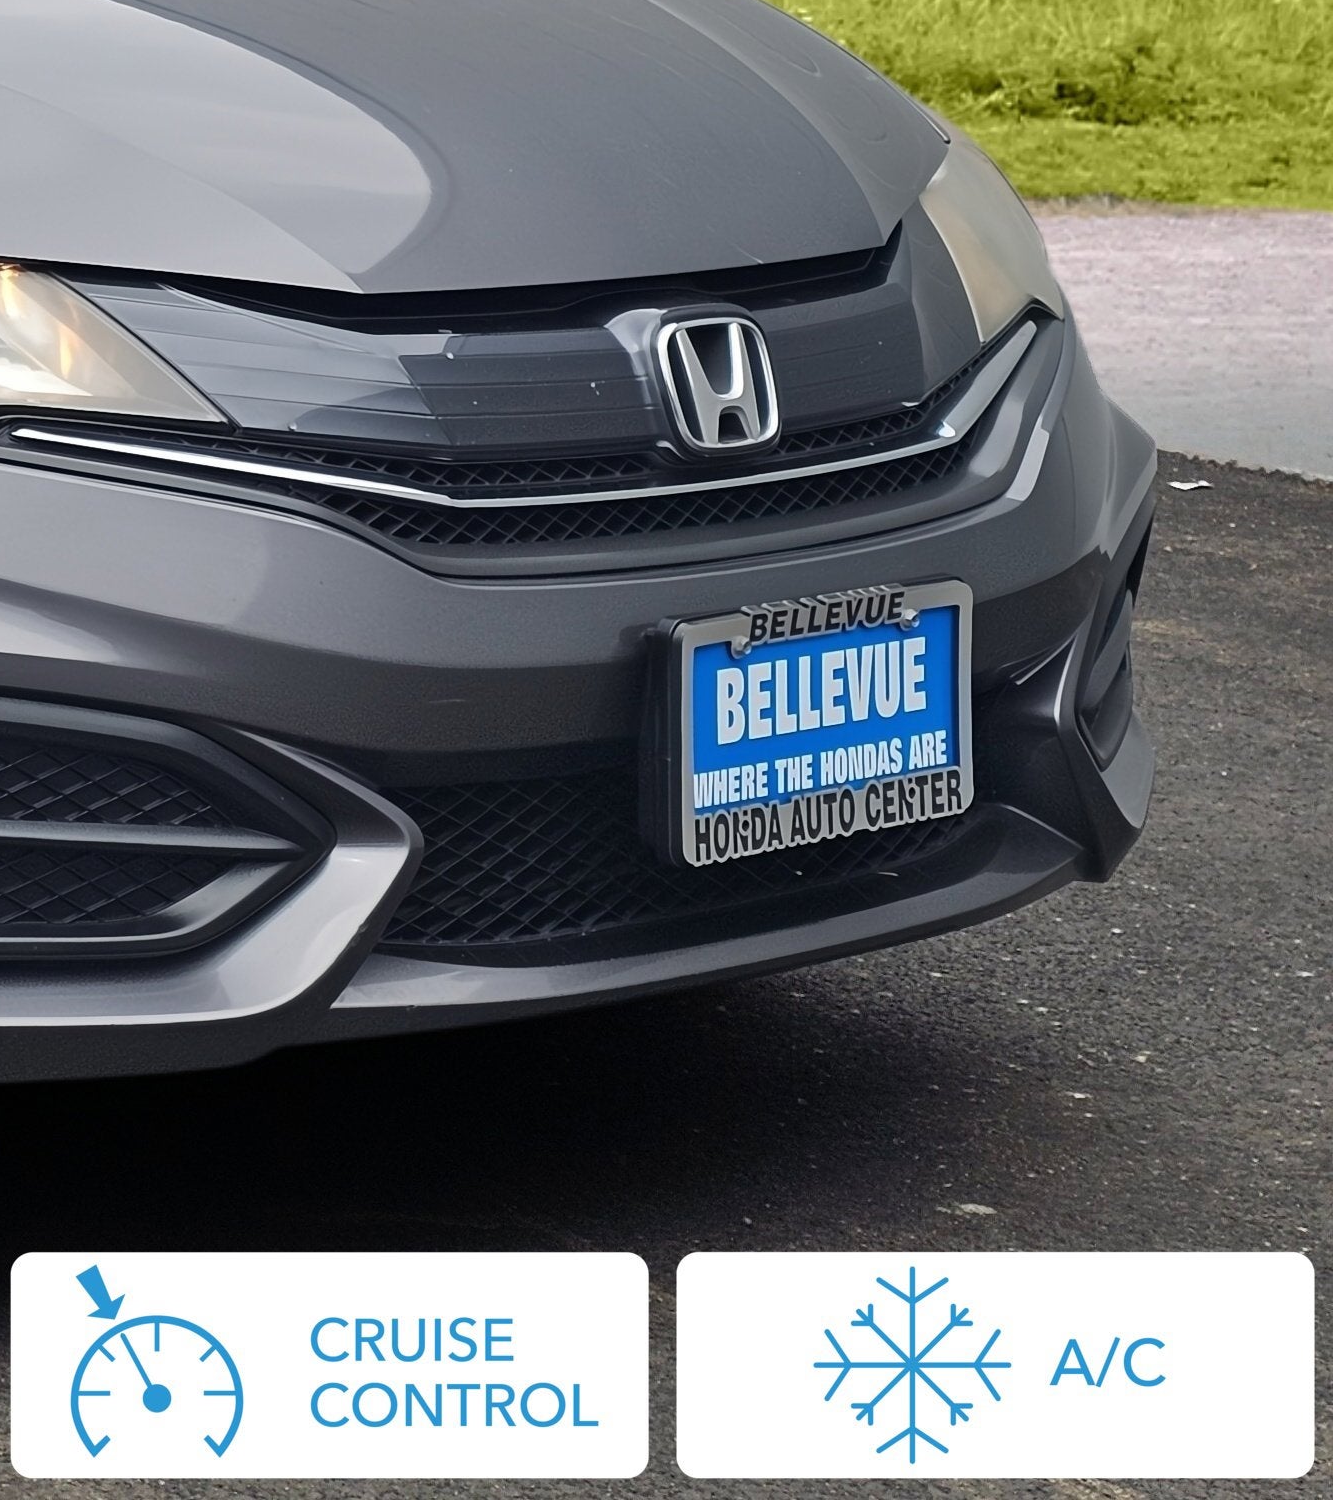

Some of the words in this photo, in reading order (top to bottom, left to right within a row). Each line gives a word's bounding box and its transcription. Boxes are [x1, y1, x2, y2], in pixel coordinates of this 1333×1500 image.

[748, 590, 906, 642] BELLEVUE
[716, 636, 927, 746] BELLEVUE
[693, 761, 769, 809] WHERE
[774, 753, 815, 794] THE
[819, 736, 903, 787] HONDAS
[908, 729, 948, 770] ARE
[694, 802, 784, 863] HONDA
[789, 787, 856, 844] AUTO
[864, 769, 964, 827] CENTER
